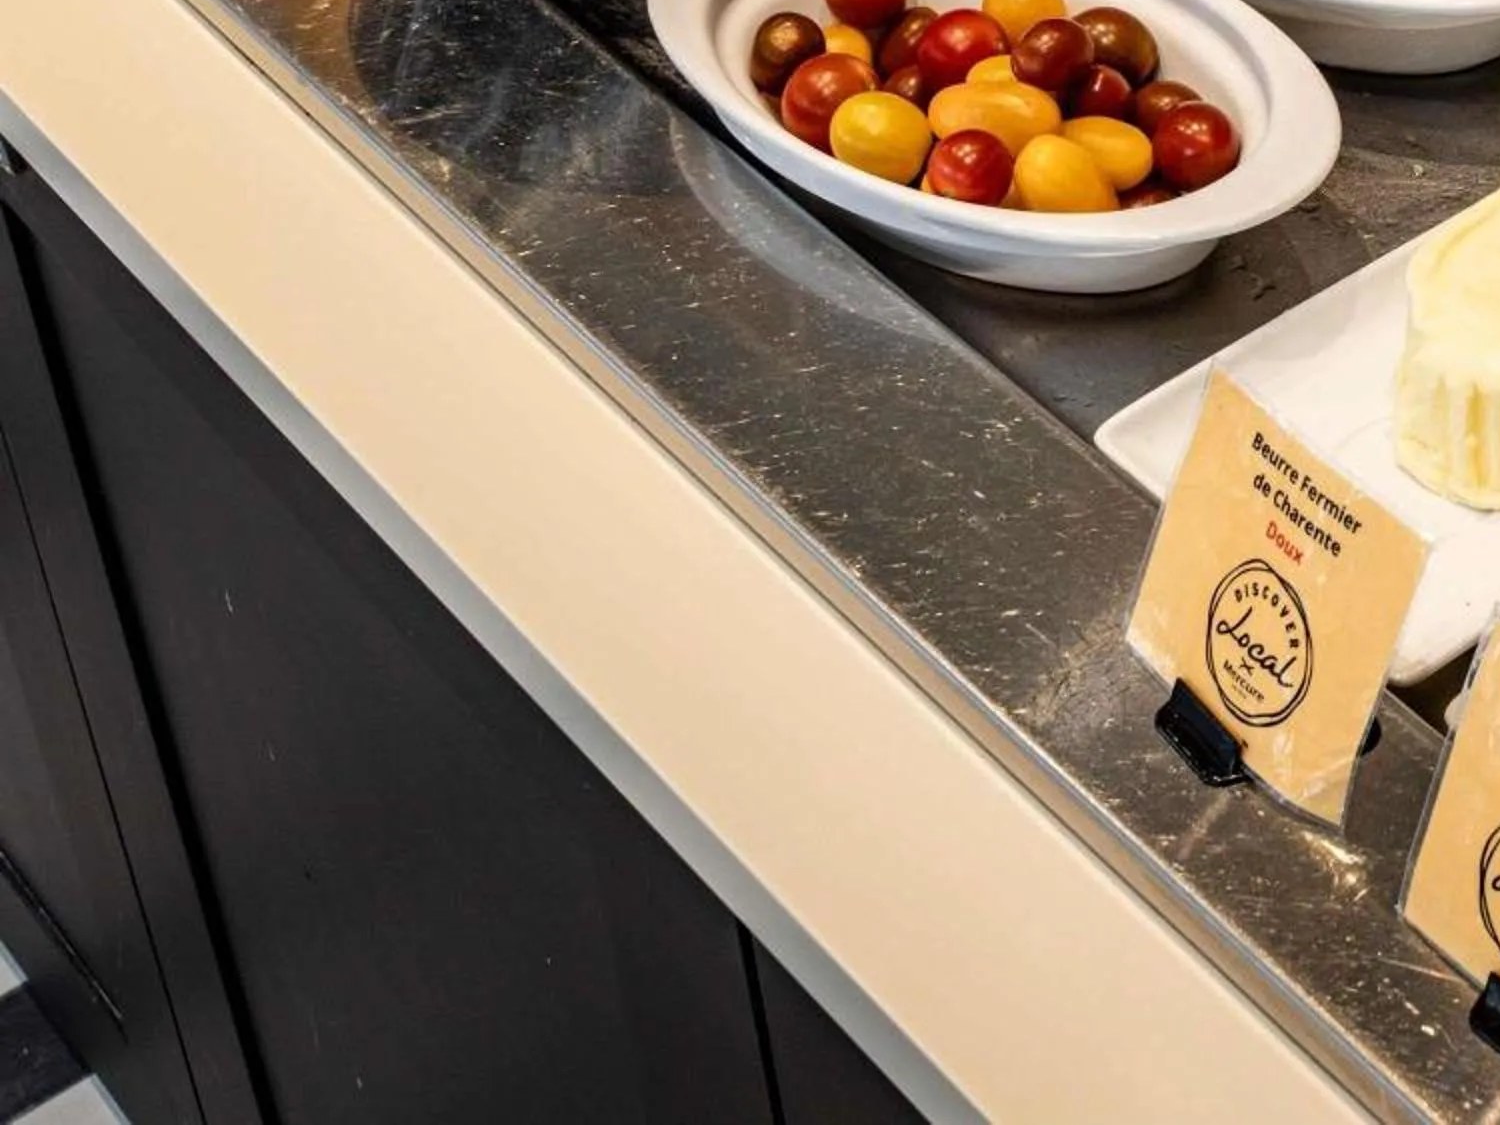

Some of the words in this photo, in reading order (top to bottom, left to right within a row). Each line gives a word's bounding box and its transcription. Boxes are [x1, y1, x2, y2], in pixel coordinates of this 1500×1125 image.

[1251, 431, 1299, 486] Beurre
[1300, 475, 1363, 536] Fermier
[1252, 475, 1273, 504] de
[1273, 489, 1342, 558] Charente
[1265, 520, 1305, 566] Doux
[1216, 606, 1297, 688] Local
[1234, 582, 1300, 649] DISCOVER
[1223, 659, 1265, 703] Mercure
